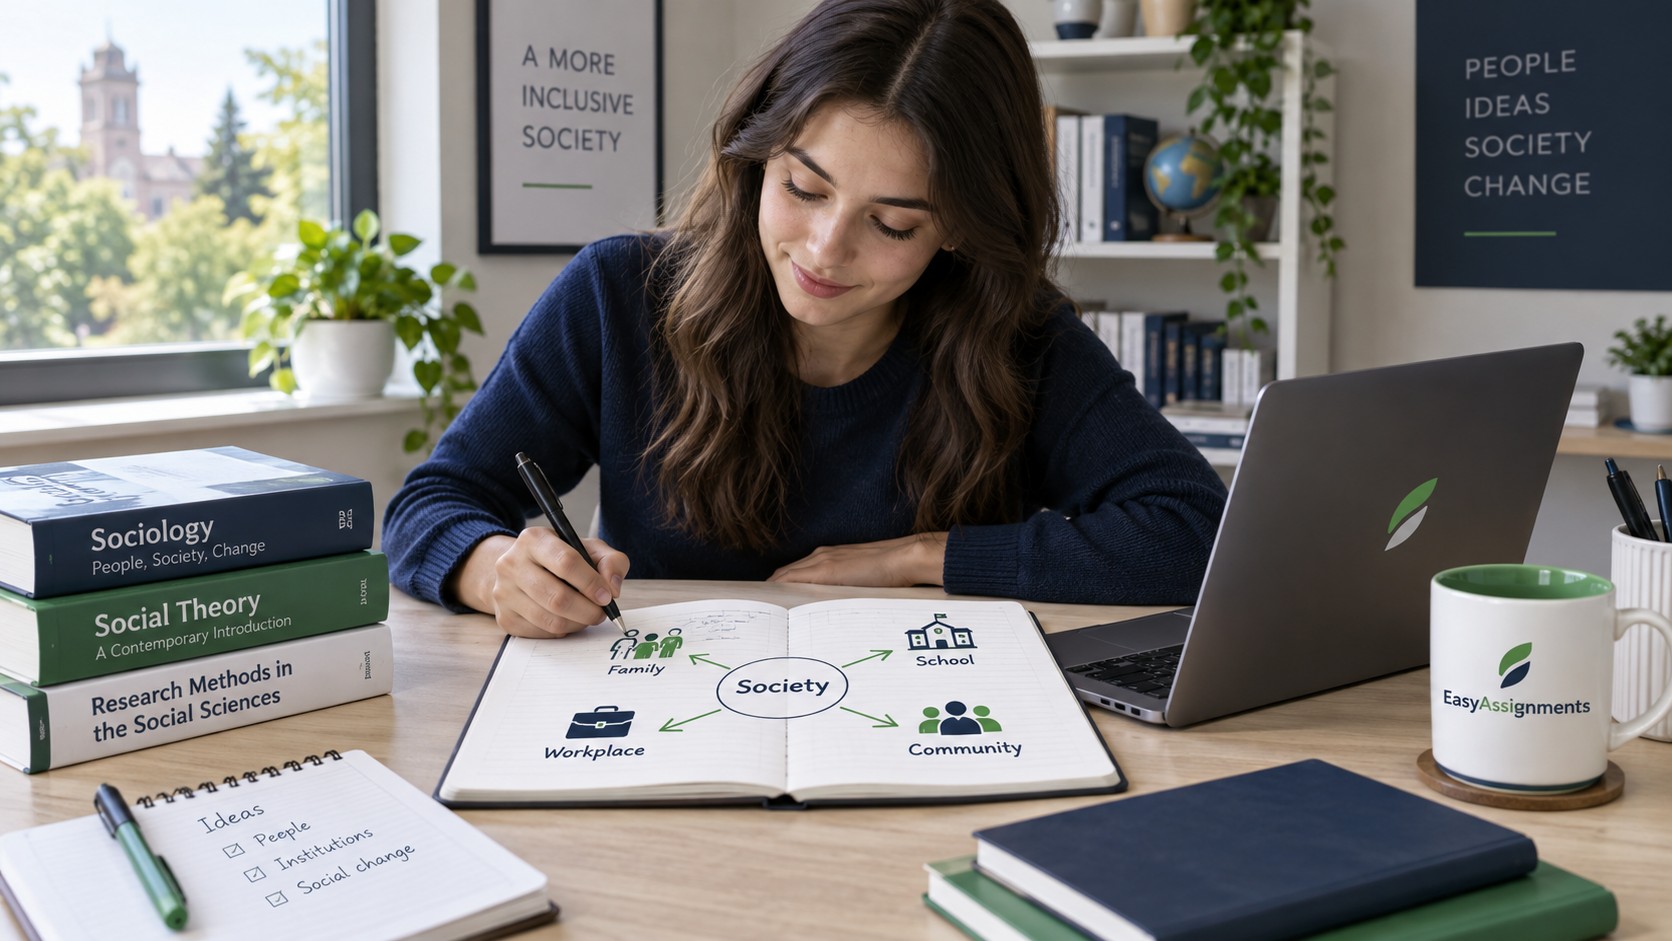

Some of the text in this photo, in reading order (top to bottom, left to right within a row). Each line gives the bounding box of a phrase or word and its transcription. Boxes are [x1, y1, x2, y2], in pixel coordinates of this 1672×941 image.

[522, 44, 615, 75] A MORE
[1465, 50, 1576, 80] PEOPLE
[522, 85, 634, 115] INCLUSIVE
[1465, 92, 1550, 119] IDEAS
[522, 125, 621, 152] SOCIETY
[1465, 131, 1592, 158] SOCIETY
[1464, 172, 1591, 197] CHANGE
[91, 519, 214, 551] Sociology
[92, 541, 266, 576] People, Society, Change
[95, 594, 260, 637] Social Theory
[95, 616, 292, 661] A Contemporary Introduction
[607, 664, 665, 677] Family
[916, 654, 975, 666] School
[91, 660, 293, 716] Research Methods in
[735, 678, 830, 697] Society
[93, 690, 281, 742] the Social Sciences
[1443, 689, 1591, 718] EasyAssignments
[544, 744, 645, 761] Workplace
[908, 741, 1022, 757] Community
[197, 804, 265, 834] Ideas
[274, 828, 374, 871] Institutions
[297, 844, 415, 895] Social change
